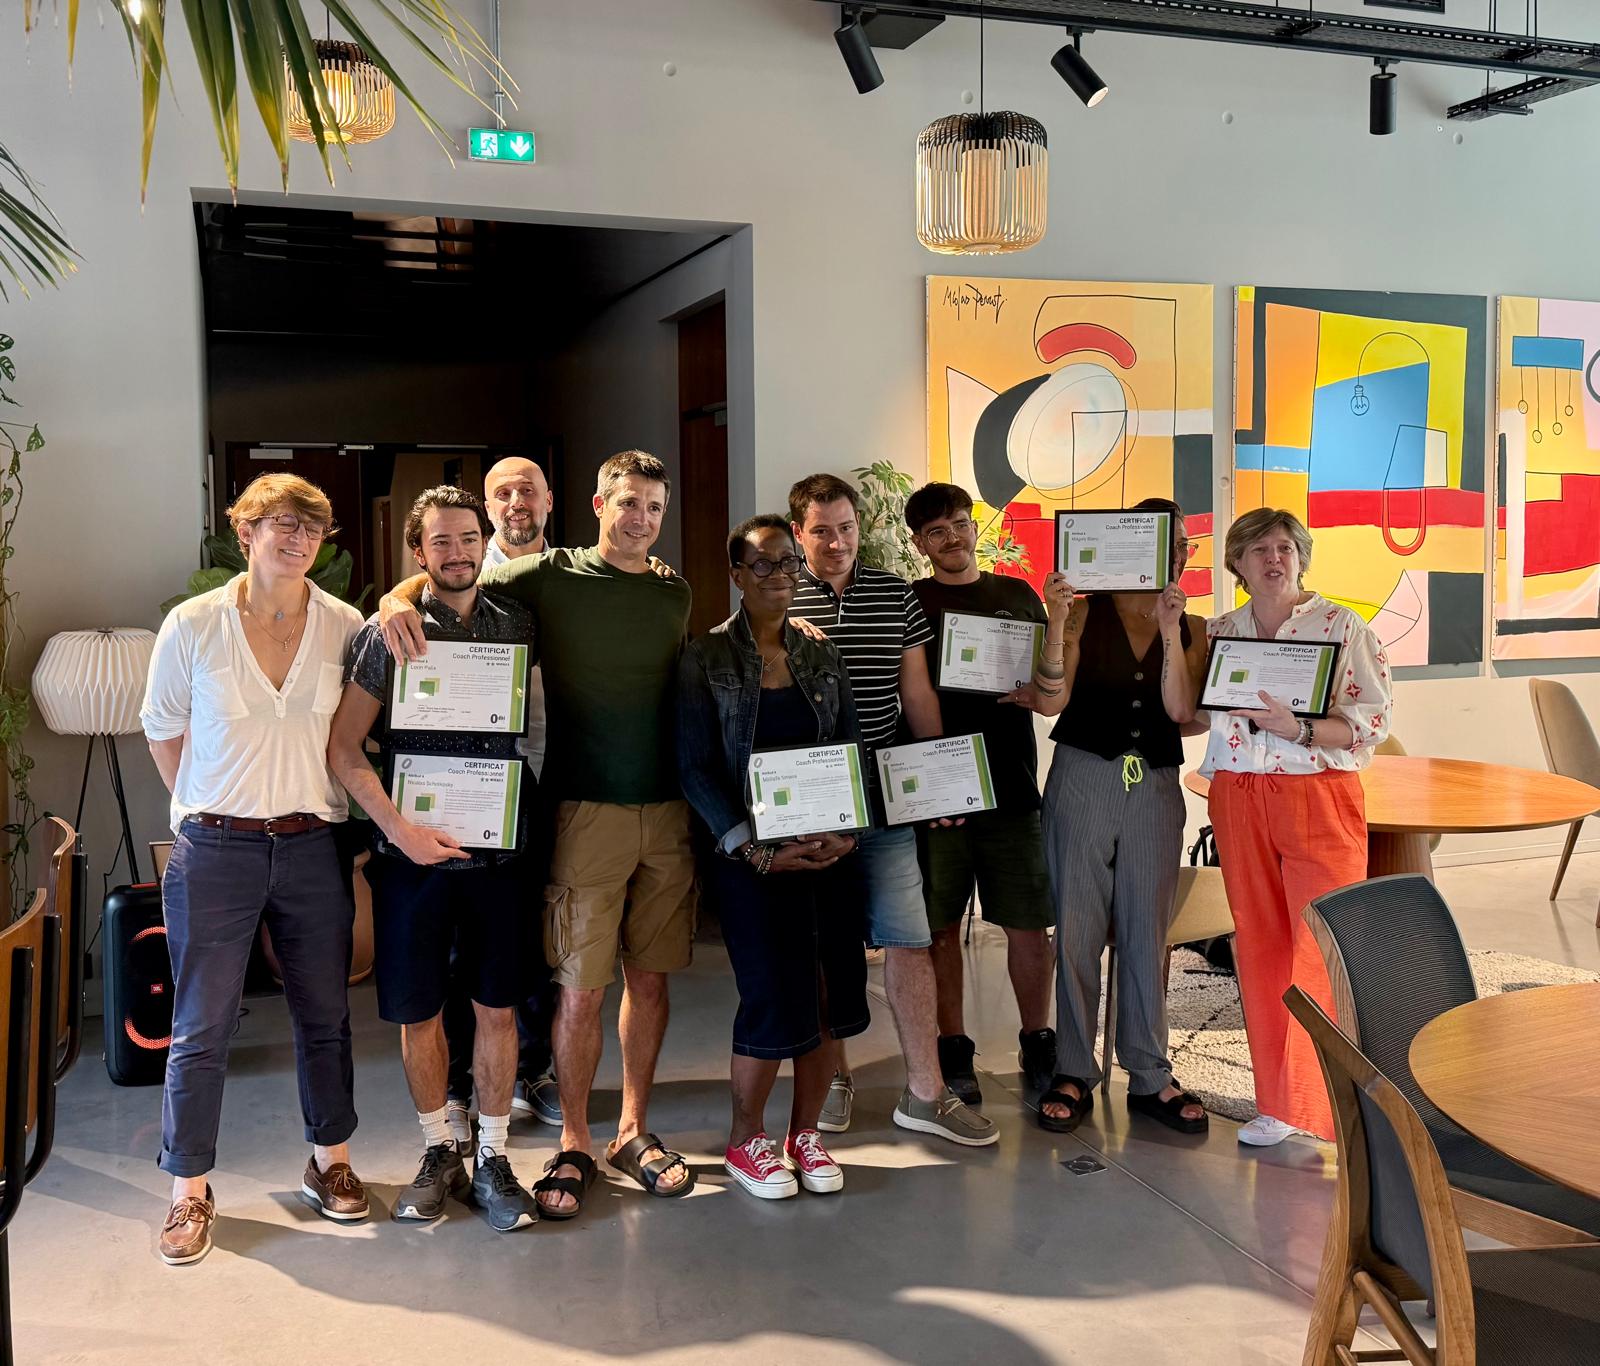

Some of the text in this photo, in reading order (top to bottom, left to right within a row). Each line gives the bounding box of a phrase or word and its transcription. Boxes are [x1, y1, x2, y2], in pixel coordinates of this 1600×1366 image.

[999, 622, 1032, 632] CERTIFICAT
[1001, 629, 1032, 637] Professionnel
[468, 646, 511, 655] CERTIFICAT
[1278, 646, 1319, 654] CERTIFICAT
[452, 652, 511, 662] Coach Professionnel
[934, 738, 969, 749] CERTIFICAT
[808, 749, 843, 758] CERTIFICAT
[922, 749, 938, 757] Coach
[938, 745, 971, 755] Professionnel
[464, 761, 505, 770] CERTIFICAT
[795, 756, 845, 766] Coach Professionnel
[447, 767, 505, 777] Coach Professionnel
